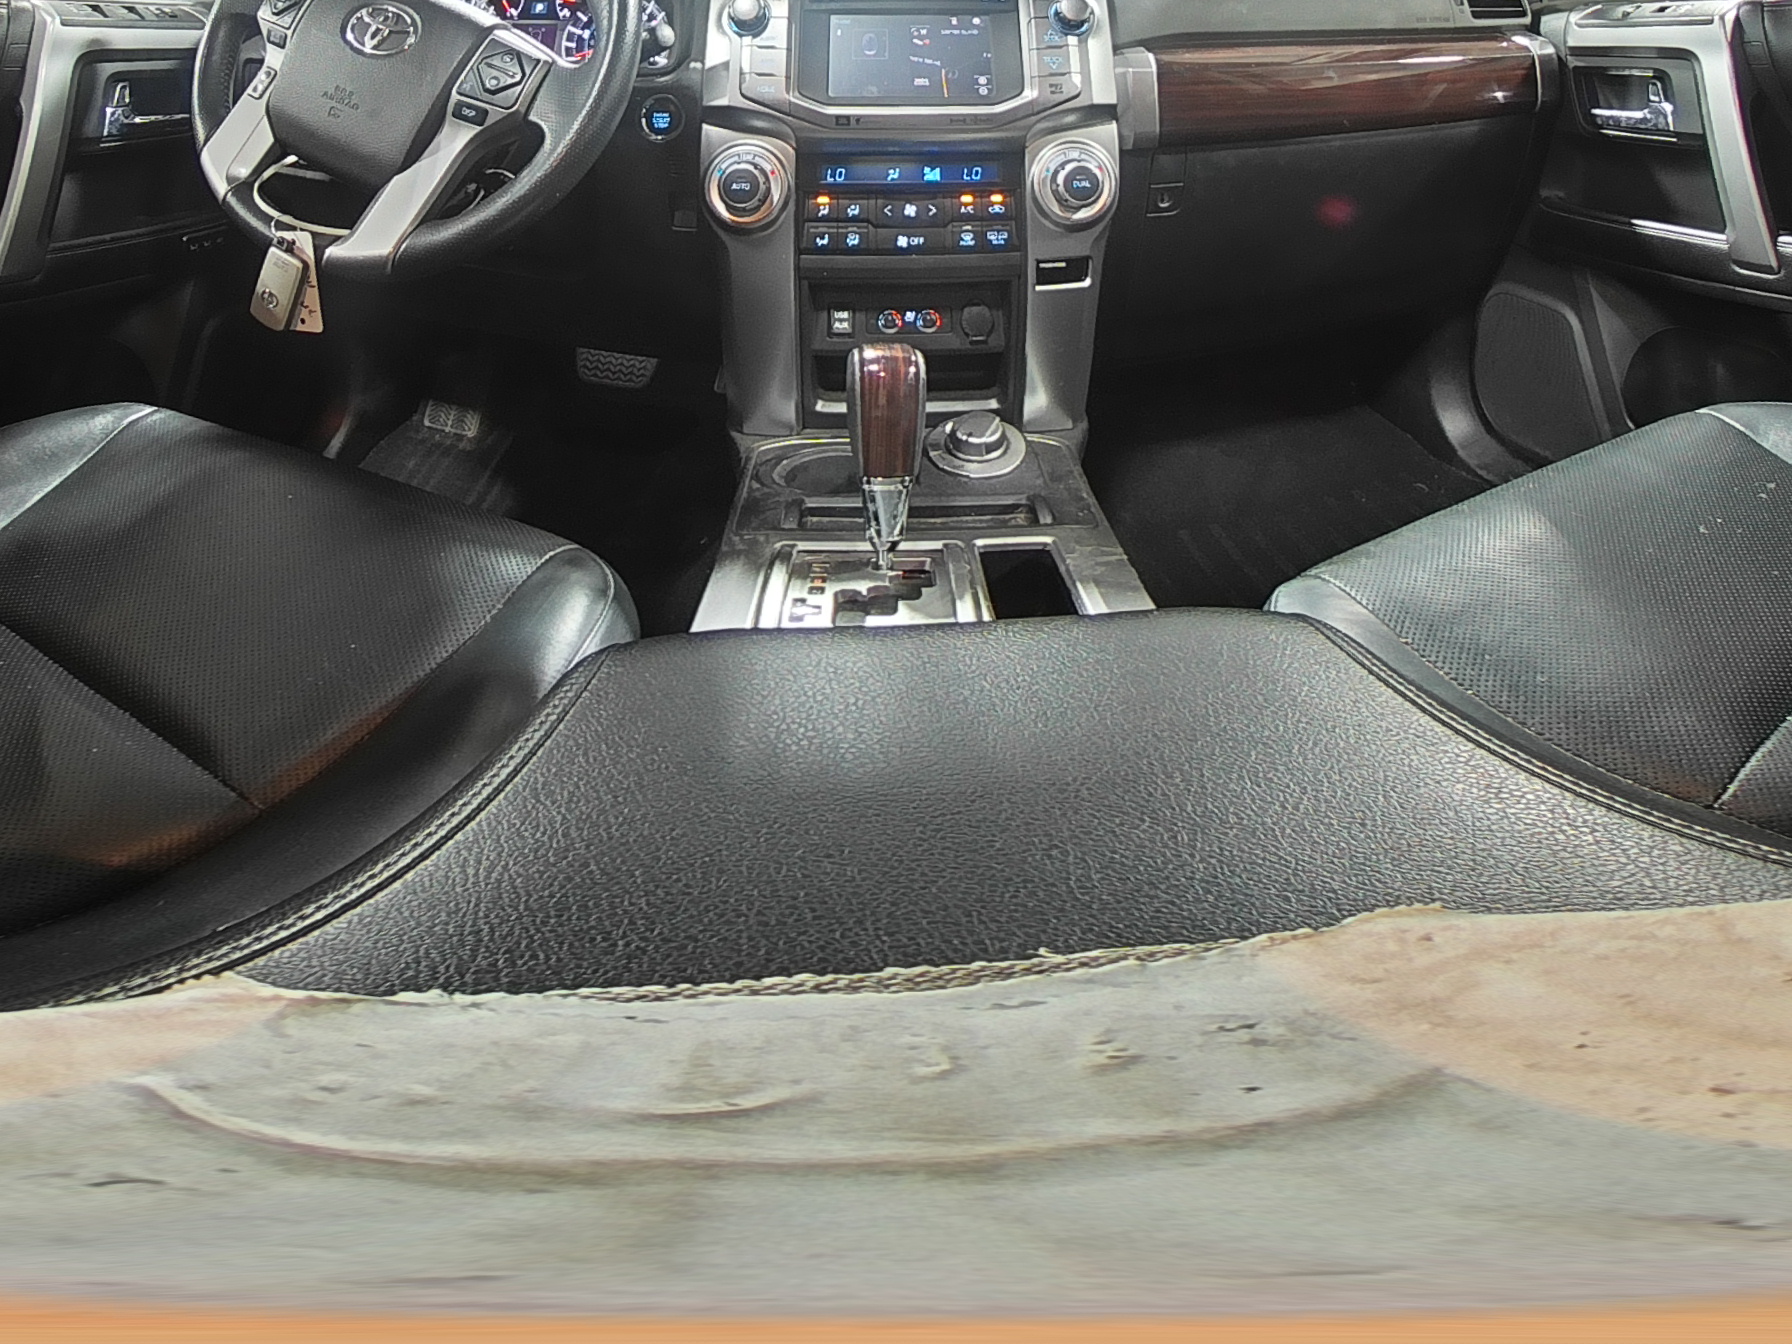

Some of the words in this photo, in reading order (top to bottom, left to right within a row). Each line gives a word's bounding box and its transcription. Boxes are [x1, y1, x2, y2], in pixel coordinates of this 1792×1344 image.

[535, 3, 544, 13] P
[826, 168, 846, 181] LO
[963, 167, 982, 180] LO
[730, 182, 751, 191] AUTO
[909, 237, 924, 245] OFF
